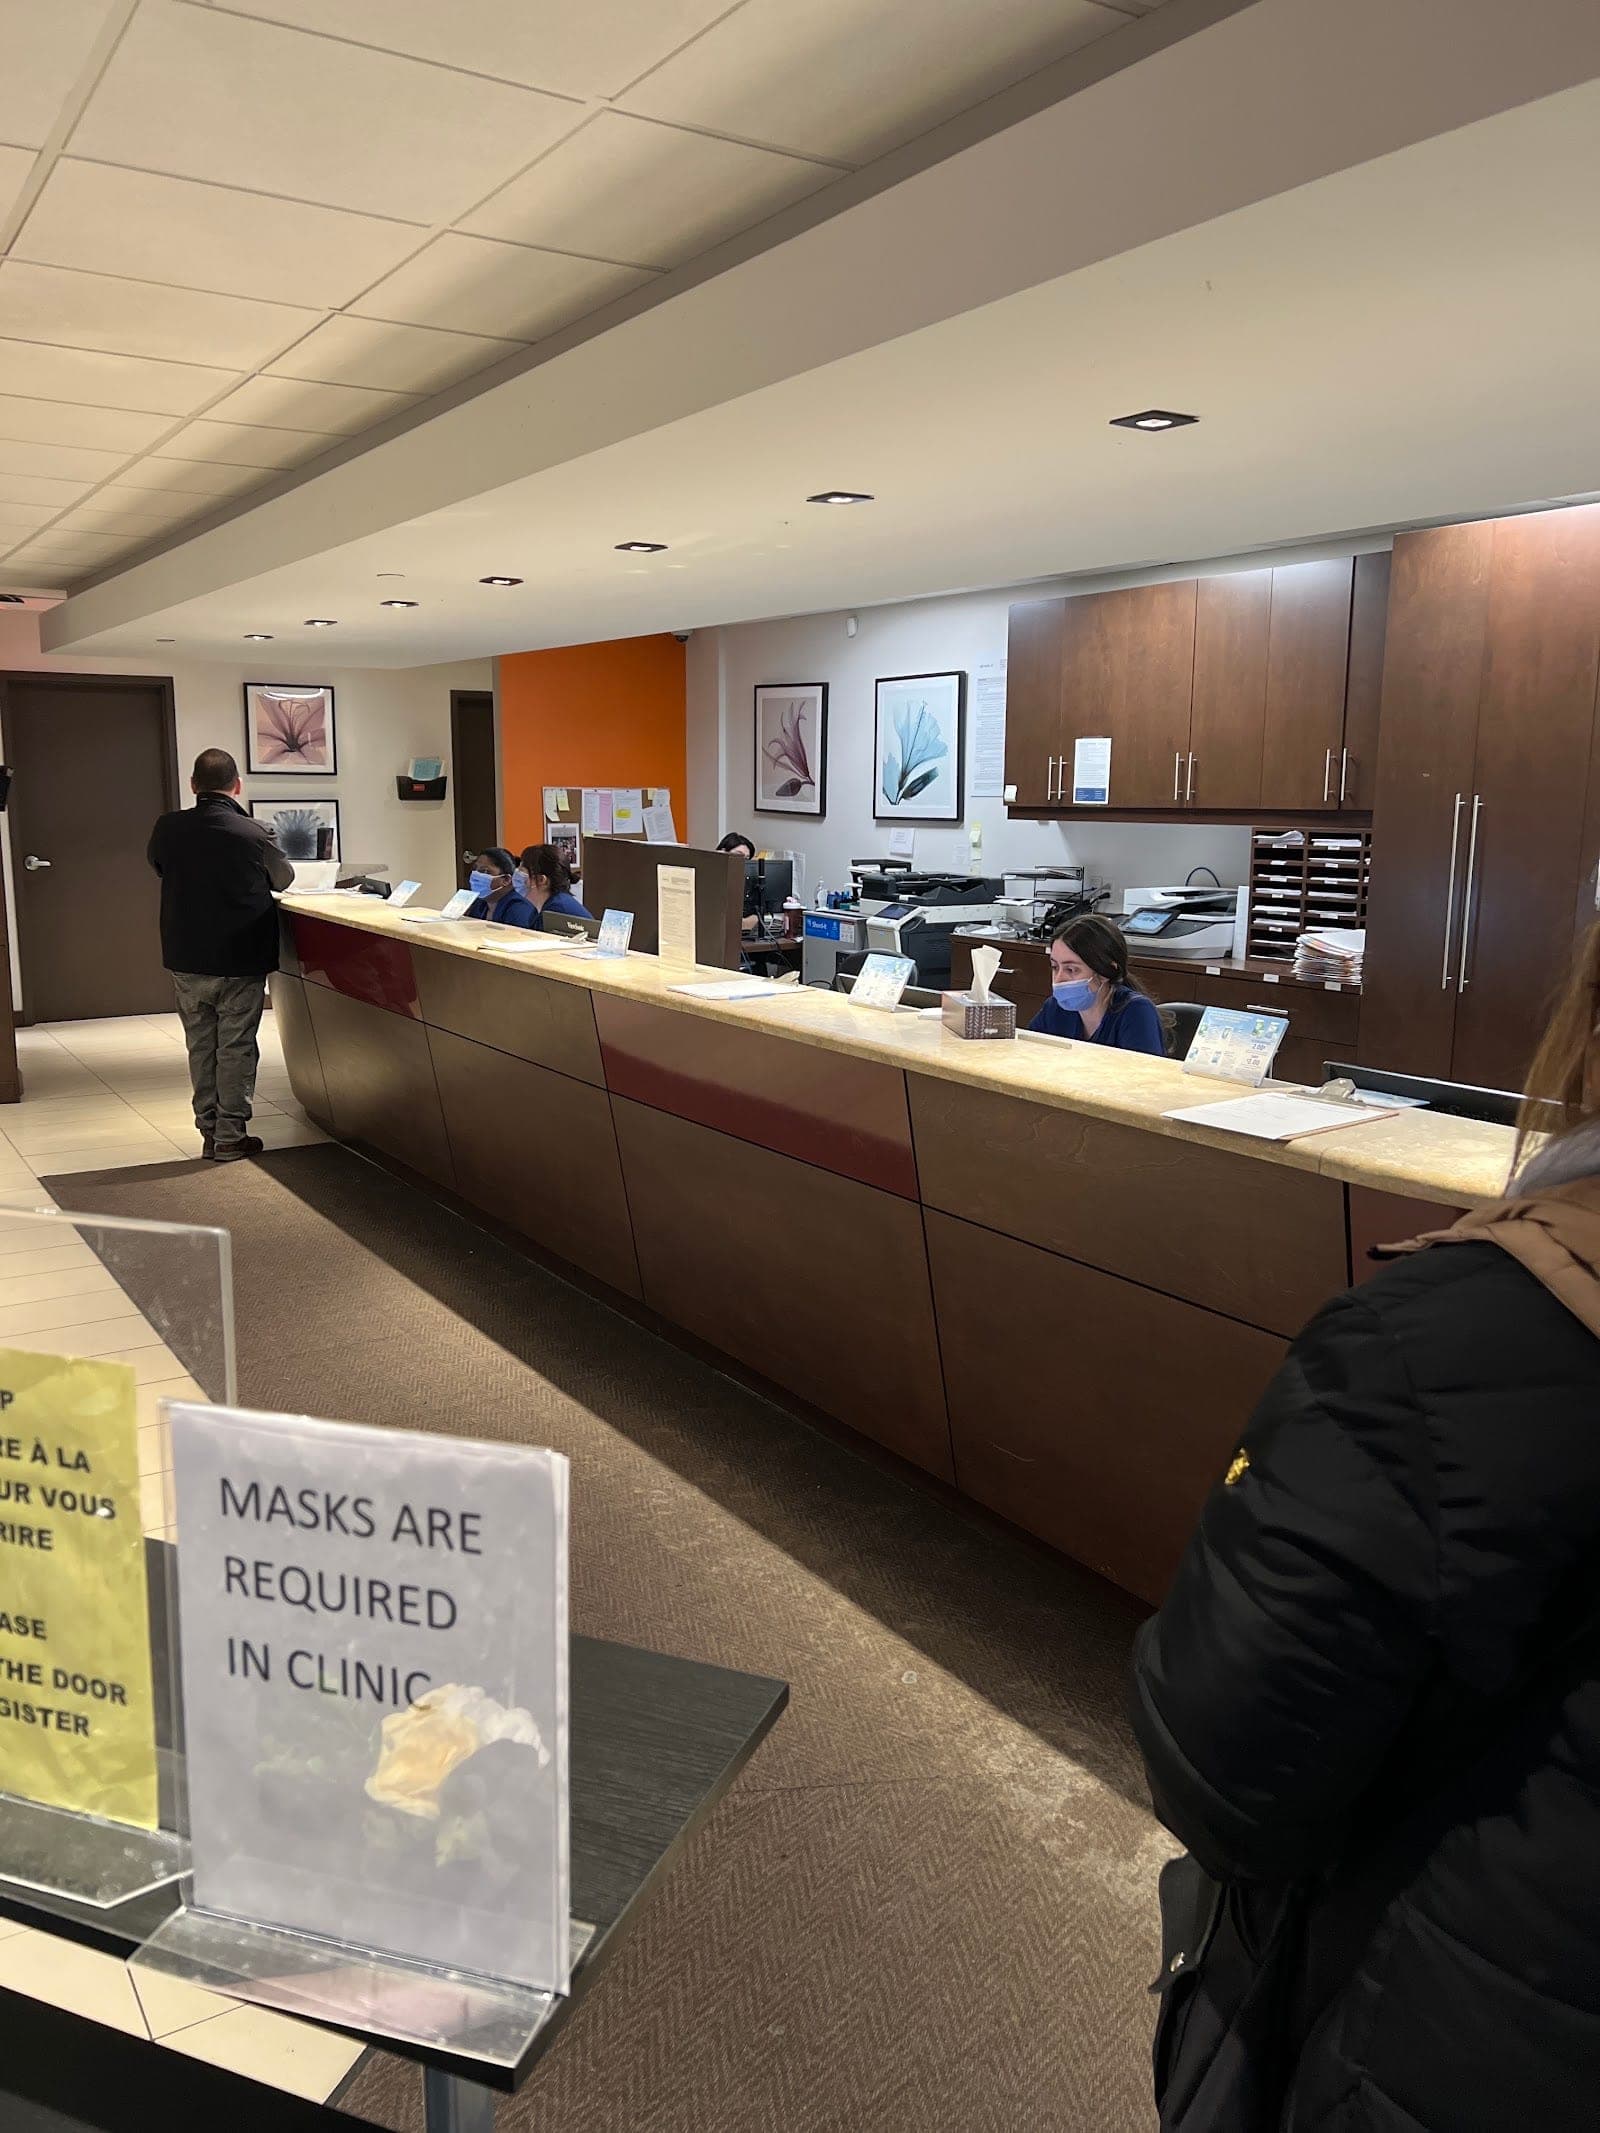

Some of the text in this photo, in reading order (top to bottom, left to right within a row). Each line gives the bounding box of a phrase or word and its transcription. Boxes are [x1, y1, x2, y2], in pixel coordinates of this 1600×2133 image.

[0, 1436, 91, 1473] E À LA
[40, 1486, 116, 1520] VOUS
[220, 1477, 482, 1555] MASKS ARE
[225, 1555, 458, 1630] REQUIRED
[0, 1612, 47, 1640] ASE
[52, 1668, 128, 1706] DOOR
[228, 1637, 431, 1710] IN CLINIC
[0, 1698, 89, 1738] GISTER
